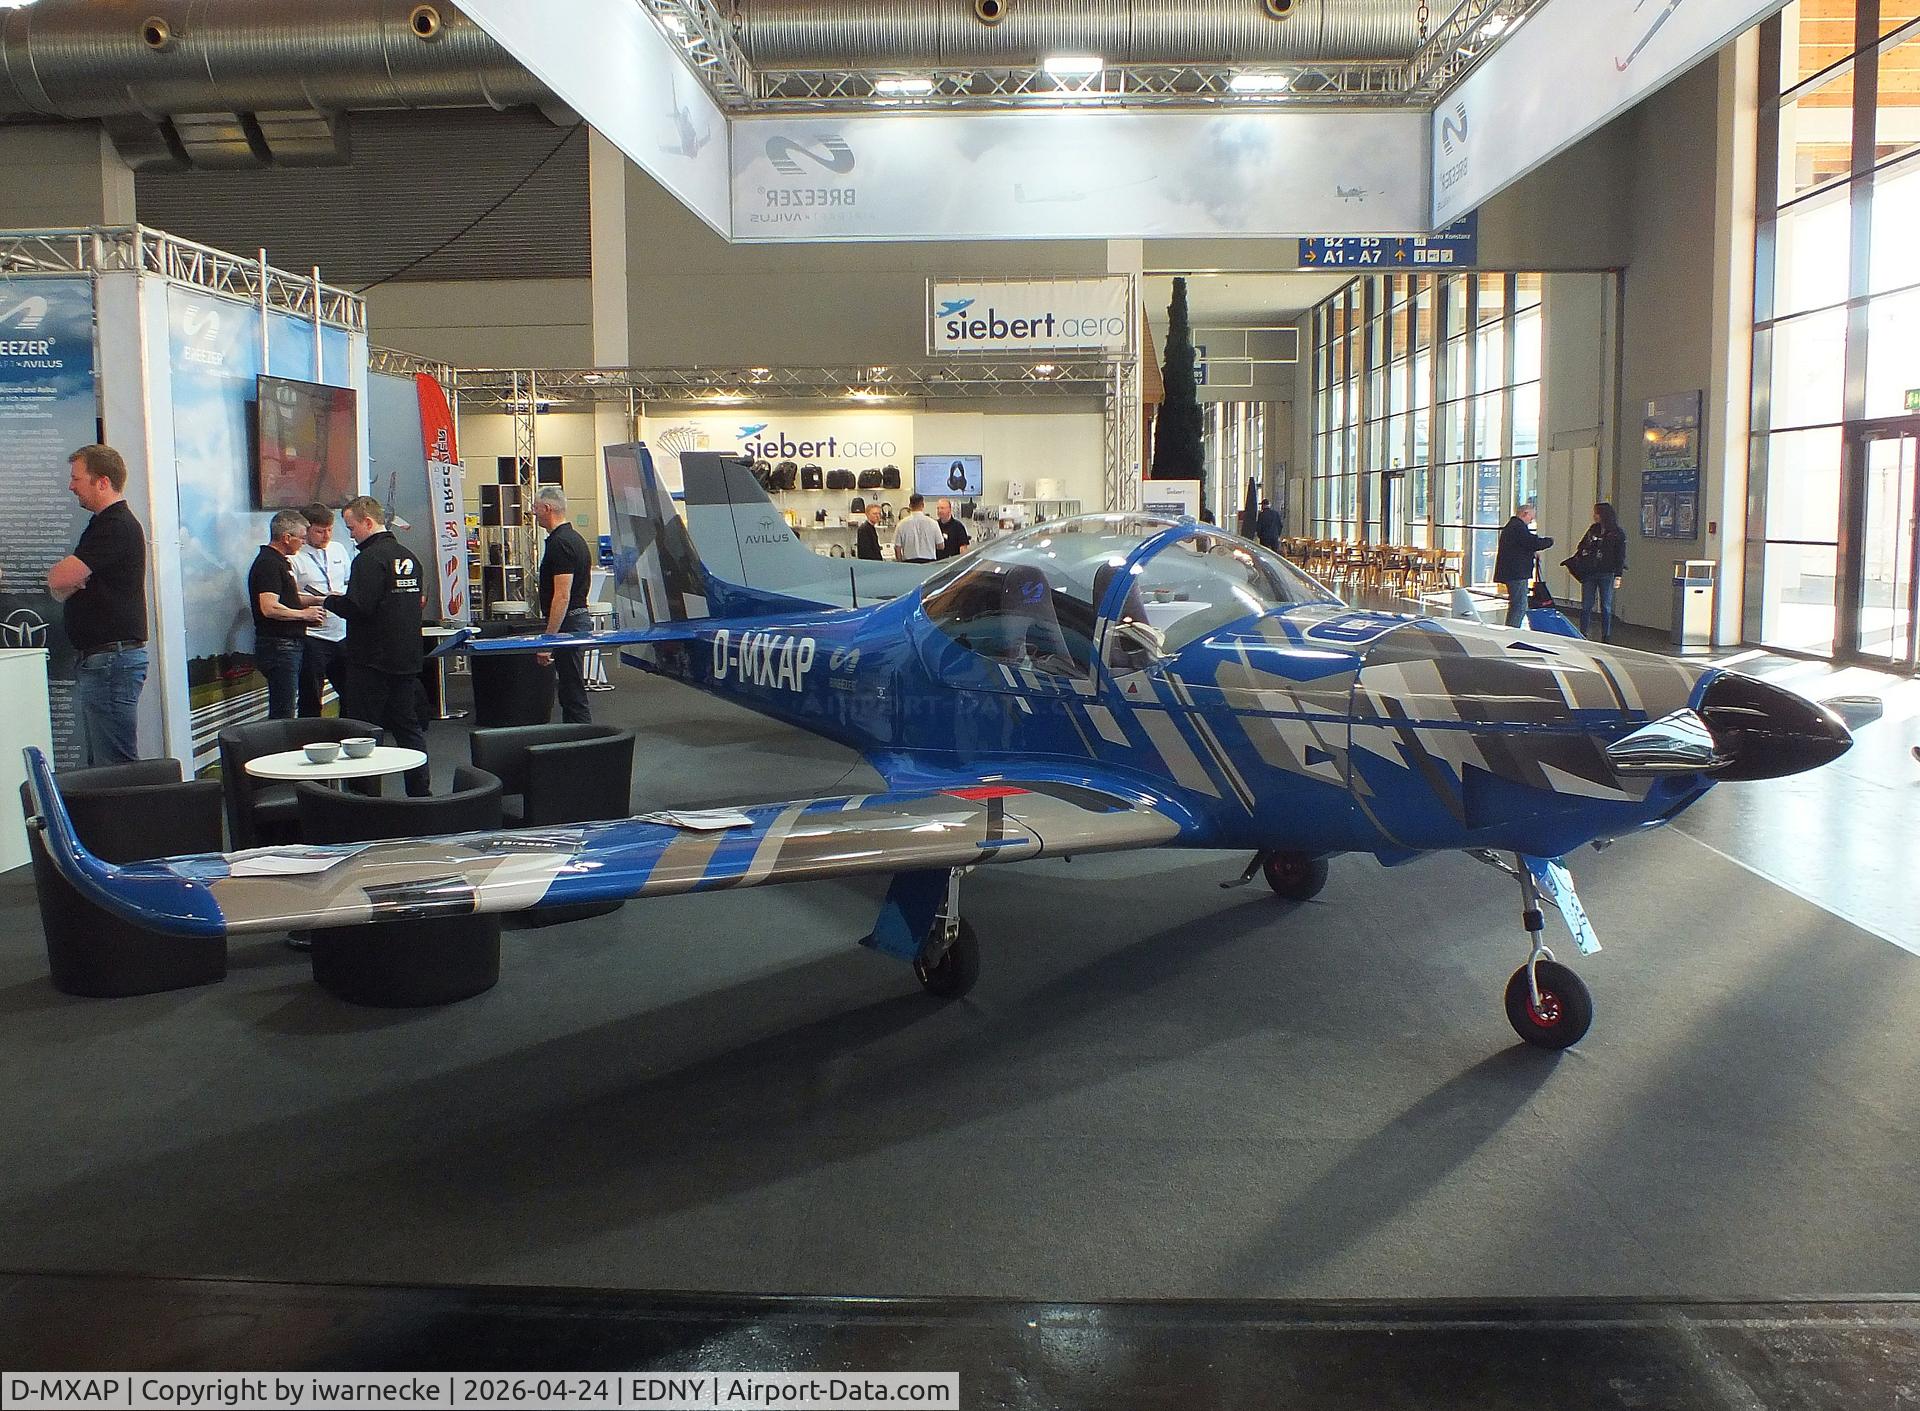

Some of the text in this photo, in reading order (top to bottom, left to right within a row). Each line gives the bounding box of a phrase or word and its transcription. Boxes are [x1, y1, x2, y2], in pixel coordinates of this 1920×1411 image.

[1323, 250, 1344, 263] A1
[1358, 250, 1382, 263] A7
[946, 308, 1125, 340] siebert.aero
[744, 432, 896, 459] siebert.aero
[745, 533, 790, 544] AVILUS
[713, 629, 815, 692] D-MXAP
